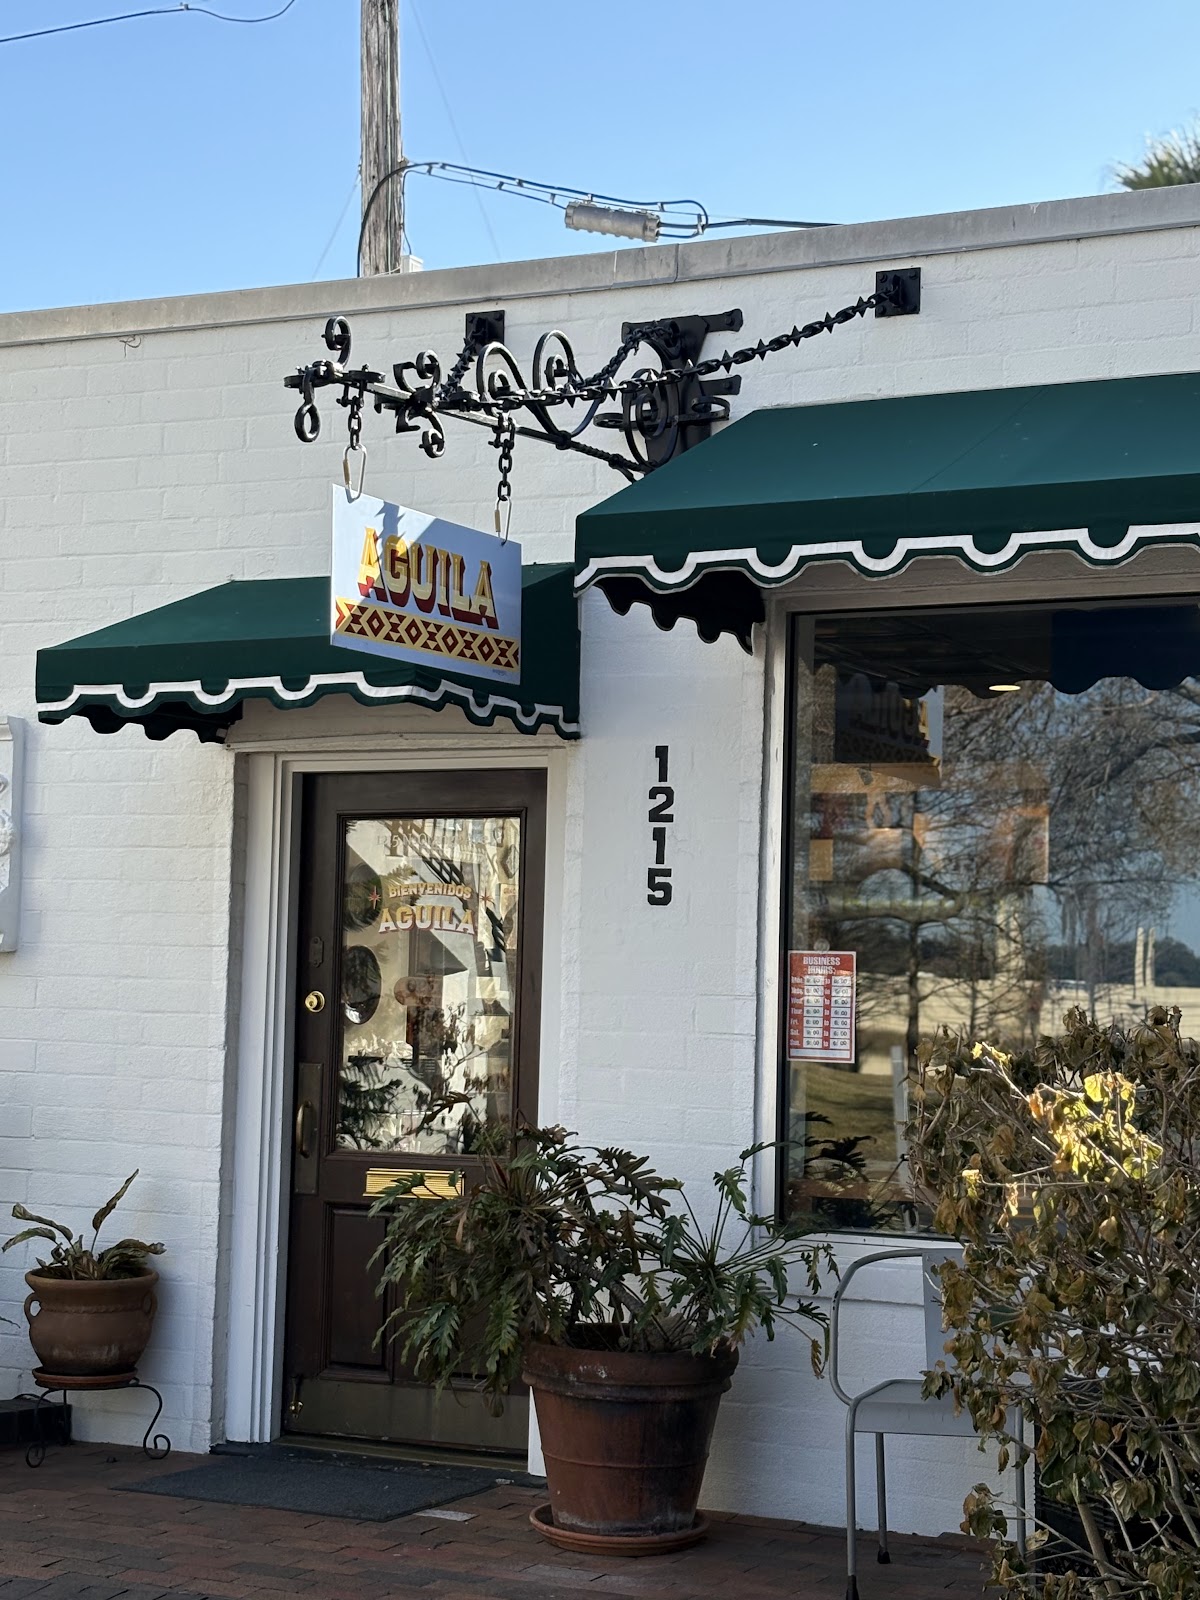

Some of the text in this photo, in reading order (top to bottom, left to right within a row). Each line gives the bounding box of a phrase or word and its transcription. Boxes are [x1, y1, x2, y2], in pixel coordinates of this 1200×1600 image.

[358, 526, 499, 630] AGUILA
[647, 745, 675, 906] 1215
[388, 883, 473, 899] BIENVENIDOS
[378, 905, 476, 935] AGUILA
[803, 956, 840, 966] BUSINESS
